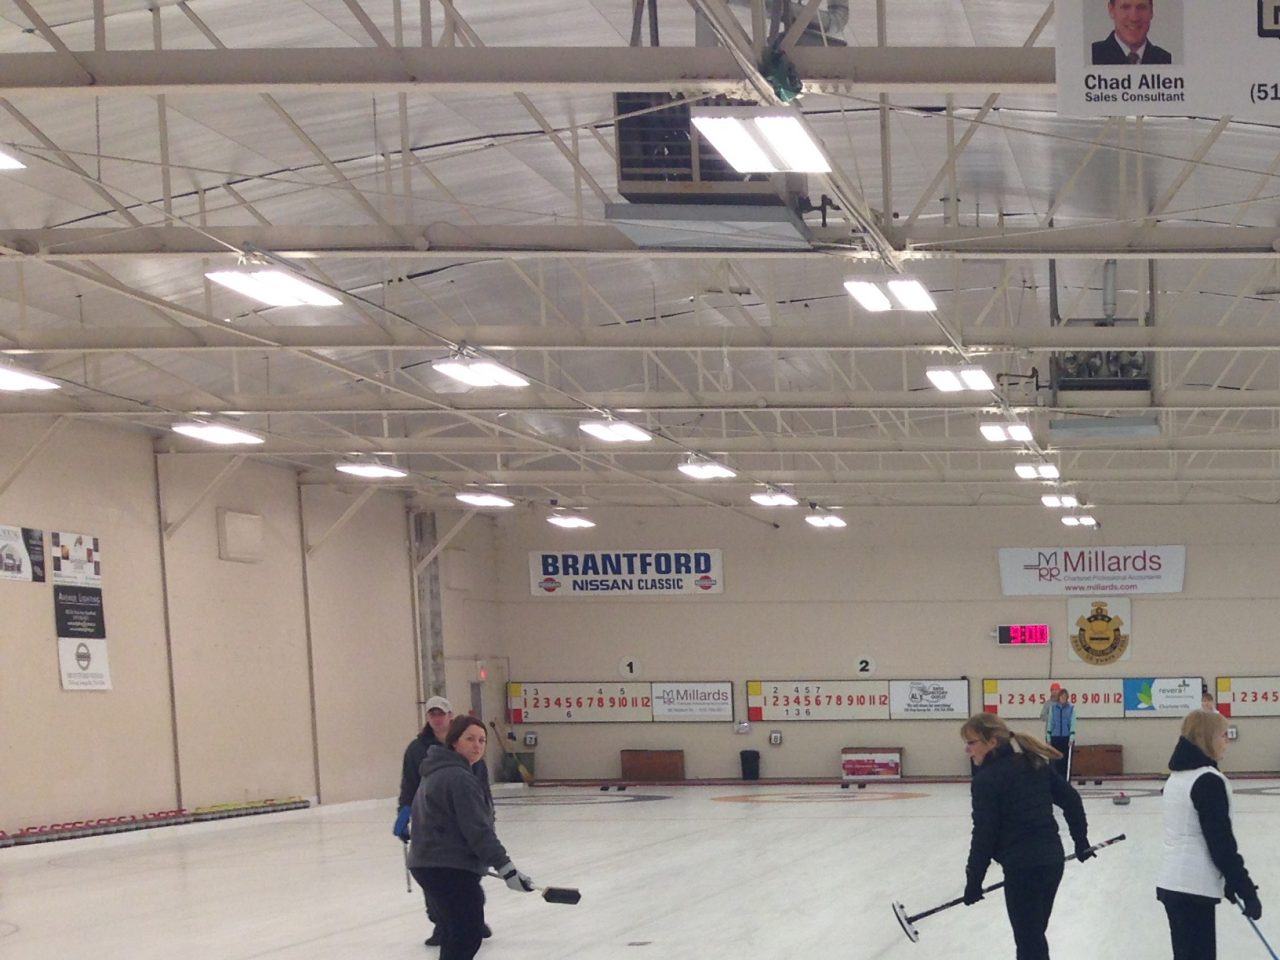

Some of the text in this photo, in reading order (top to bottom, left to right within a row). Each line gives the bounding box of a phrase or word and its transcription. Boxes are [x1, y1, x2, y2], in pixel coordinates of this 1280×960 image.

[1085, 74, 1184, 90] Chad Allen
[1085, 91, 1185, 102] Sales Consultant
[541, 552, 712, 576] BRANTFORD
[1064, 550, 1162, 572] Millards
[572, 579, 633, 591] NISSAN
[638, 578, 683, 590] CLASSIC
[627, 662, 634, 673] 1
[859, 660, 870, 672] 2
[676, 689, 729, 701] Millards
[763, 695, 887, 706] 1 2 3 4 5 6 7 8 9 10 11 12
[999, 692, 1122, 704] 1 2 3 4 5 8 9 10 11 12
[1232, 692, 1235, 702] 1
[1241, 692, 1247, 702] 2
[1251, 692, 1257, 702] 3
[1261, 692, 1268, 701] 4
[1272, 692, 1278, 701] 5
[523, 696, 650, 708] 1 2 3 4 5 6 7 8 9 10 11 12
